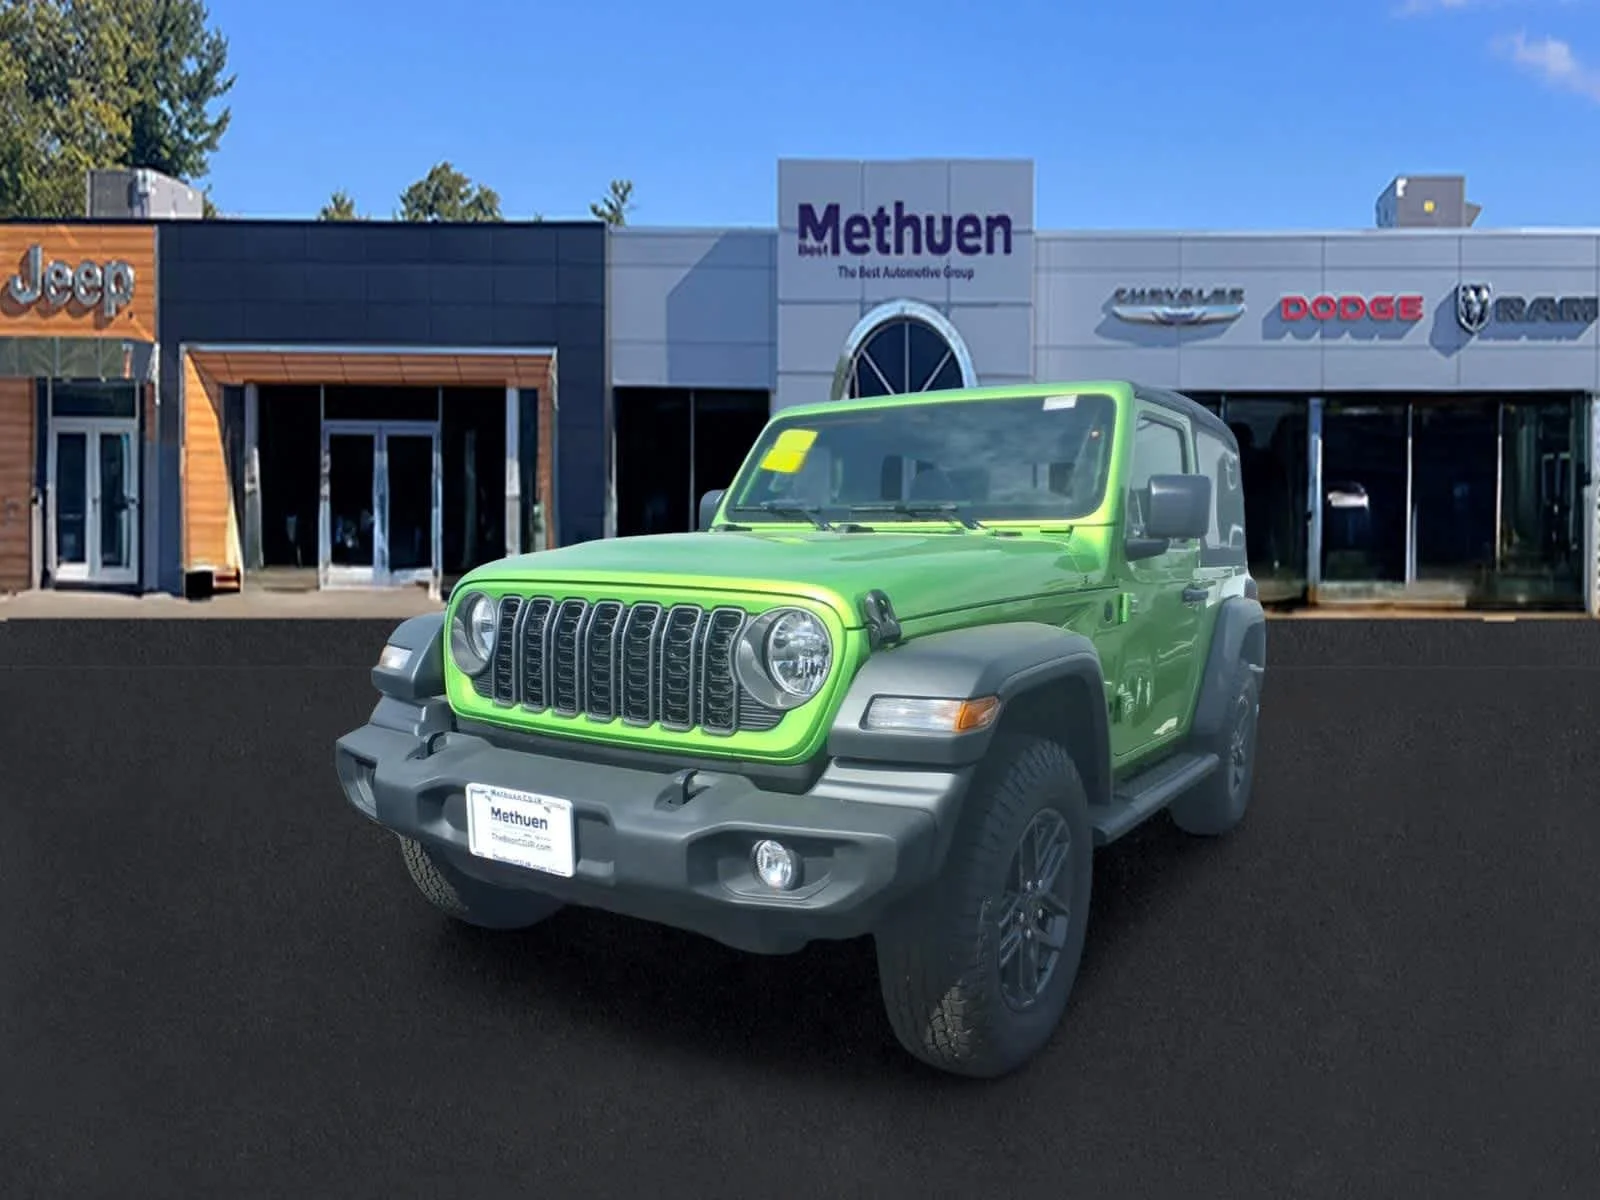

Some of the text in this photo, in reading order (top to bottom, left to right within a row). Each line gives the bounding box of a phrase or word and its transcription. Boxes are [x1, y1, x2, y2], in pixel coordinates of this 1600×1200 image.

[798, 201, 1012, 255] Methuen
[9, 243, 135, 317] Jeep
[838, 265, 974, 281] The Best Automotive Group
[1281, 295, 1424, 321] DODGE
[1495, 296, 1599, 322] RAM
[490, 806, 548, 830] Methuen
